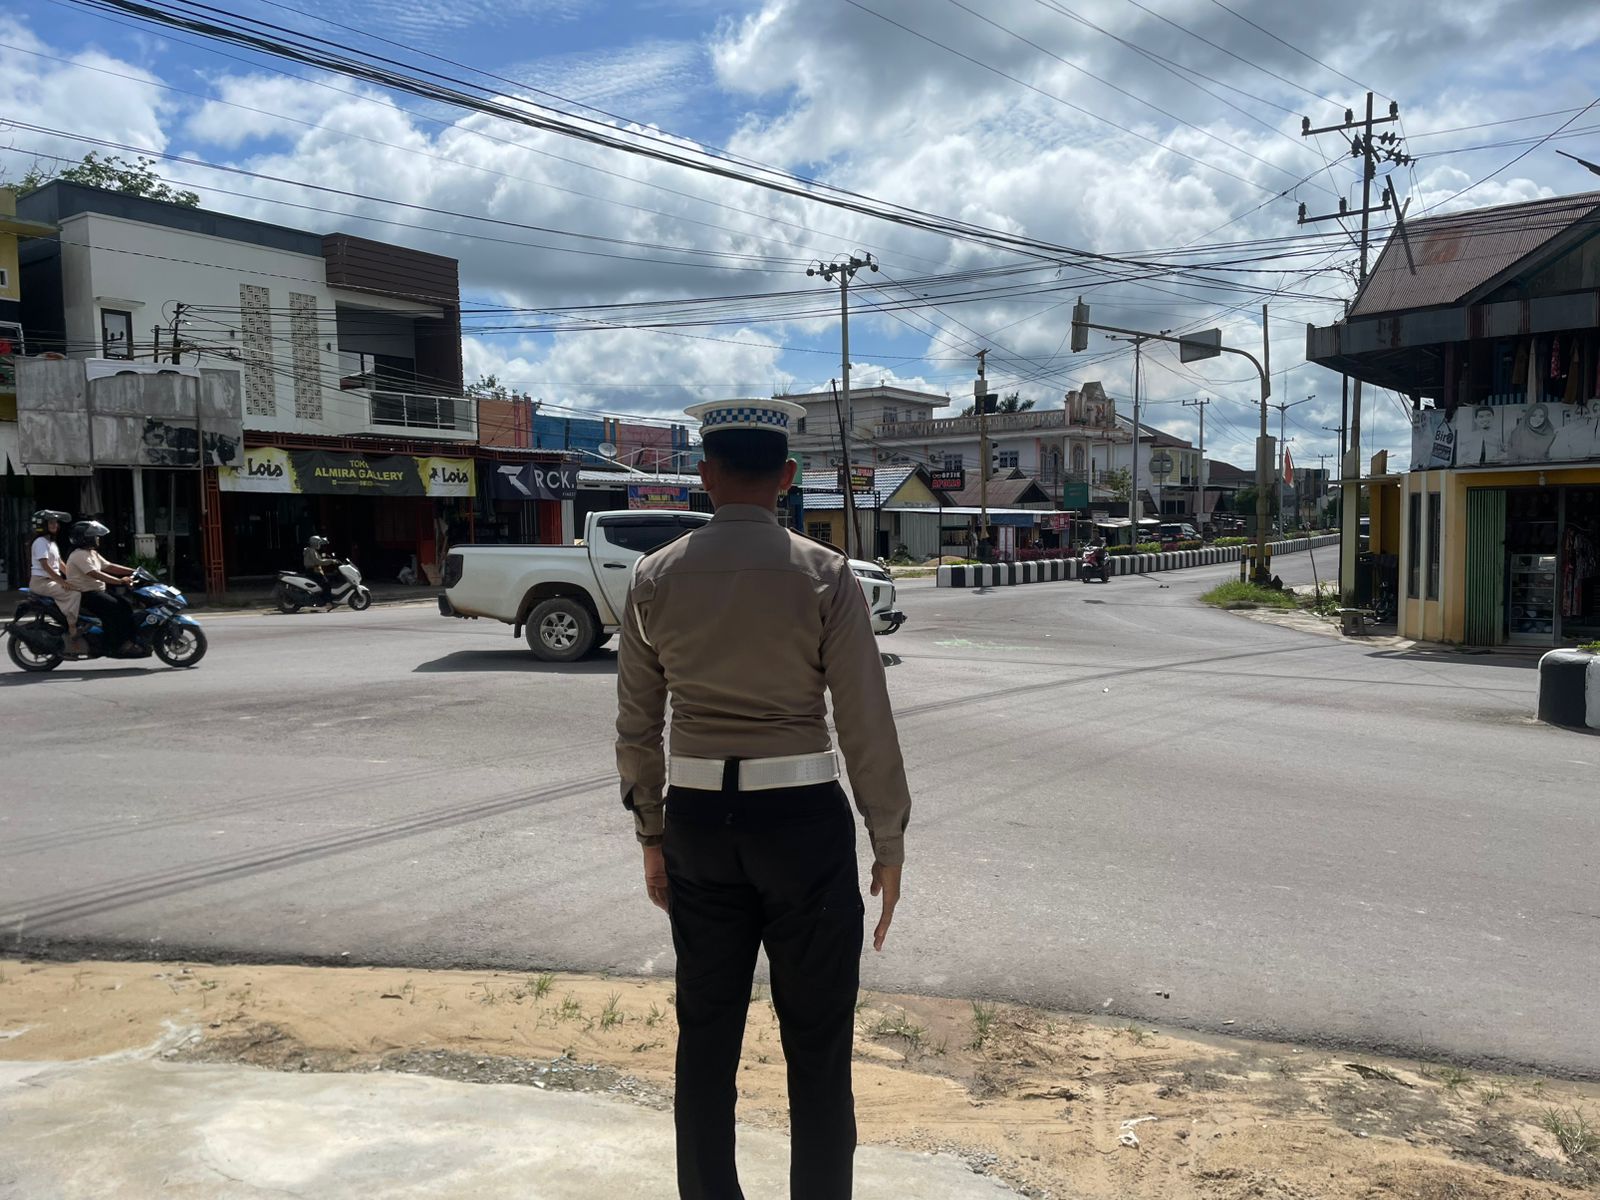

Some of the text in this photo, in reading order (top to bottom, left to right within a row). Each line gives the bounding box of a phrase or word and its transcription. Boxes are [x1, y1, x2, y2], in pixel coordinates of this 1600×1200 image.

[248, 458, 283, 477] Lois
[315, 467, 403, 480] ALMIRA GALLERY
[442, 467, 469, 483] Lois
